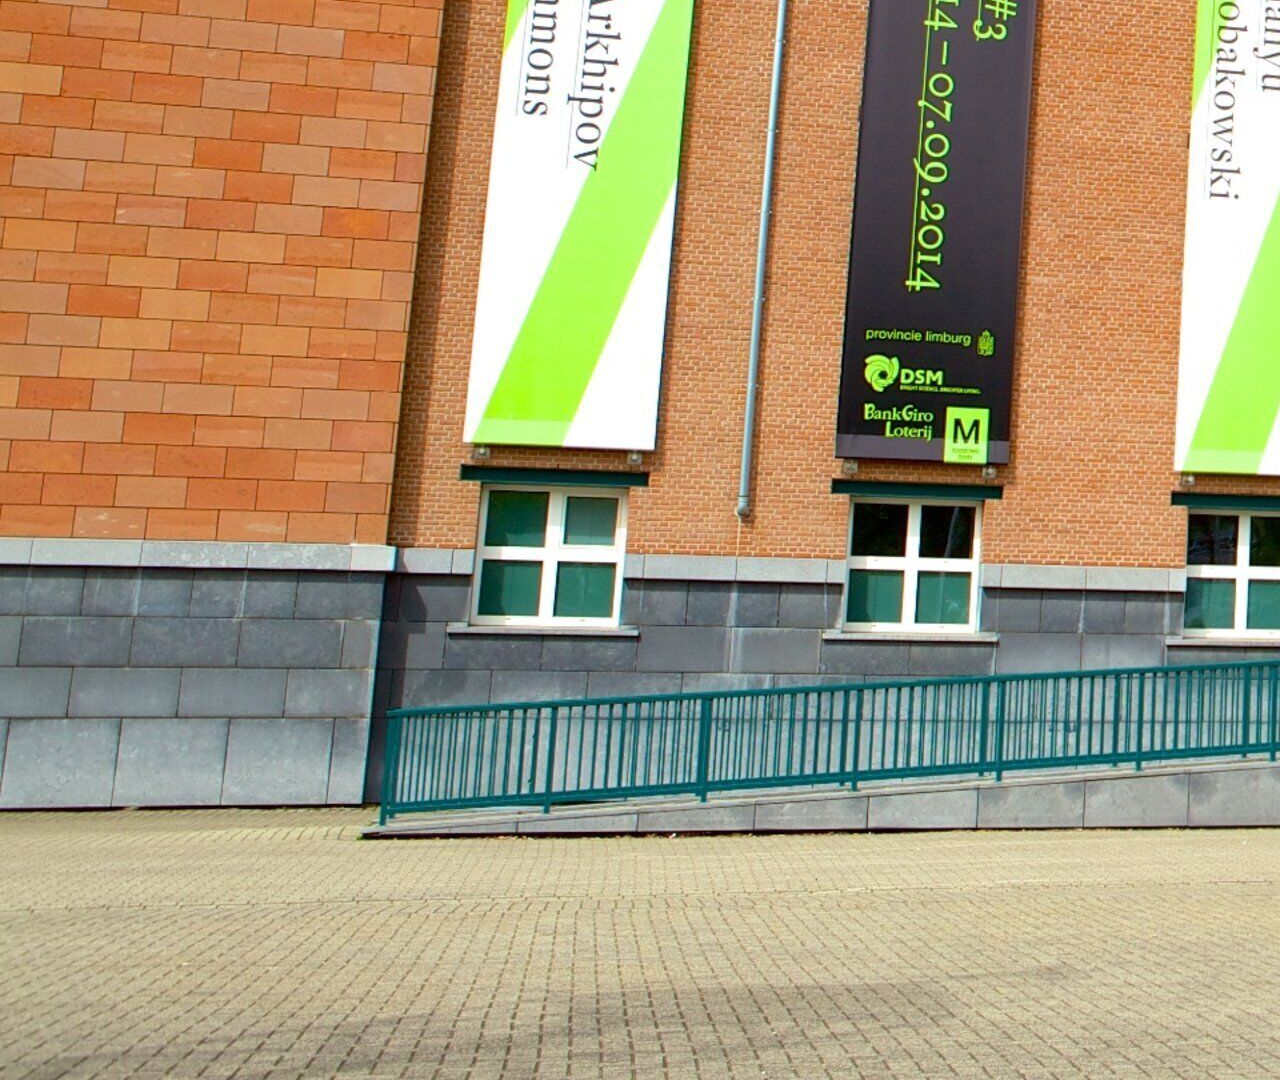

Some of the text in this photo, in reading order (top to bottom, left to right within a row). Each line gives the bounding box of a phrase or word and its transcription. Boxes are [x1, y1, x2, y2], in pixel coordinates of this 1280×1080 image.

[904, 73, 955, 293] 07.09.2014
[865, 328, 972, 347] provincie limburg
[900, 368, 943, 386] DSM
[864, 402, 934, 422] BankGiro
[885, 421, 933, 443] Loterij
[953, 418, 980, 444] M
